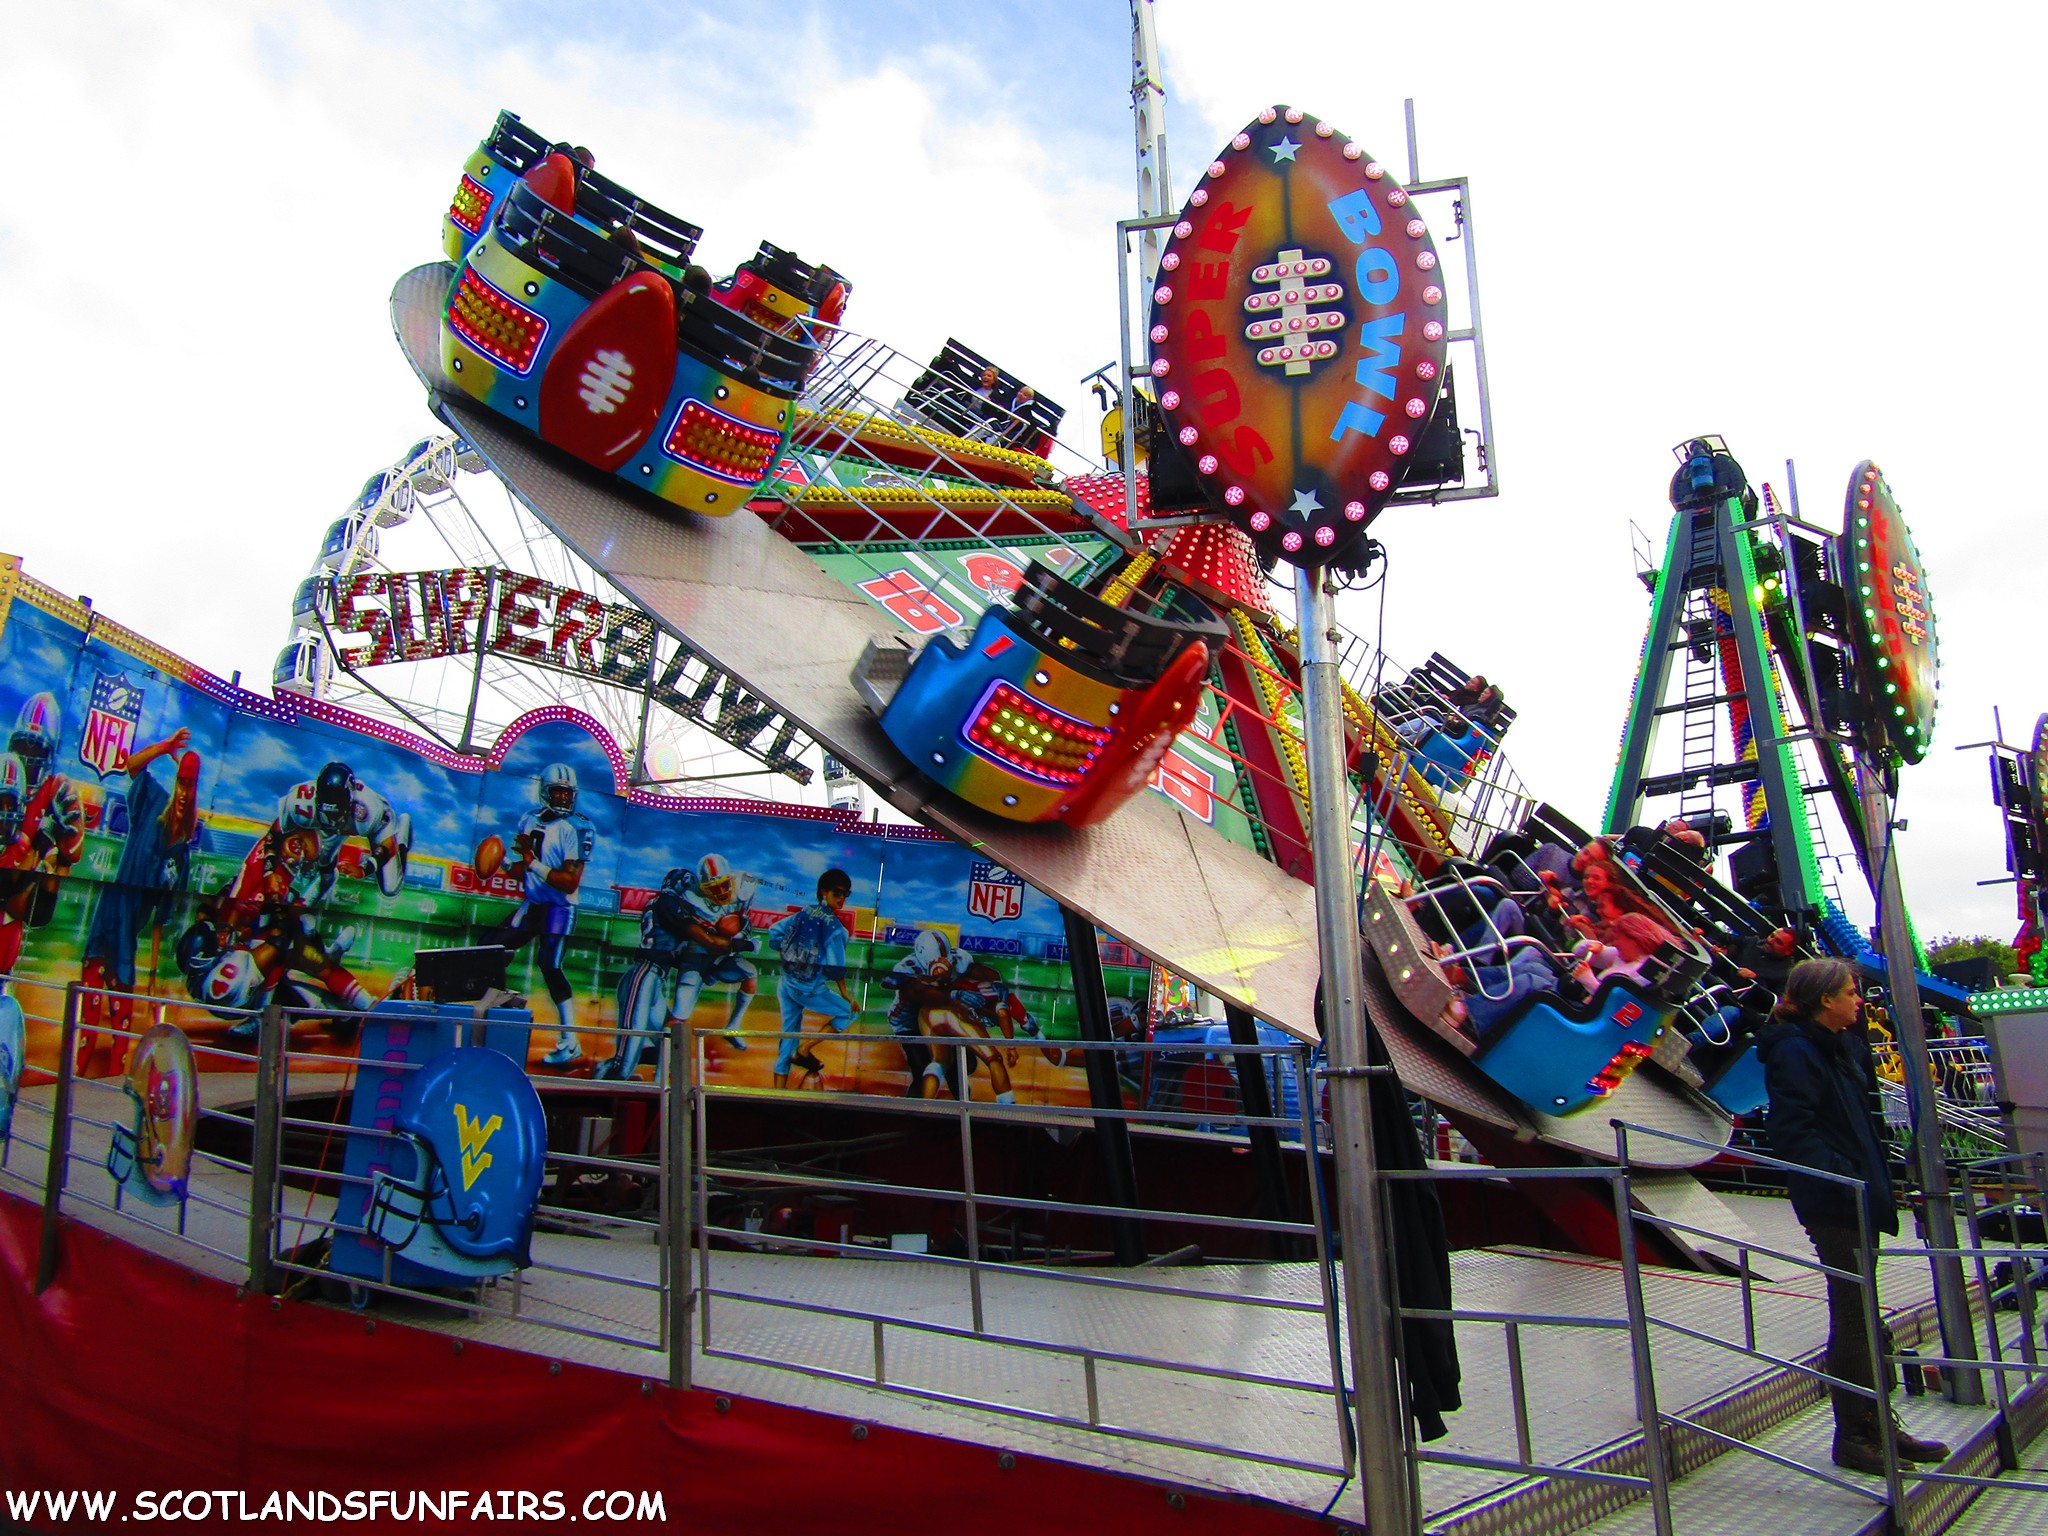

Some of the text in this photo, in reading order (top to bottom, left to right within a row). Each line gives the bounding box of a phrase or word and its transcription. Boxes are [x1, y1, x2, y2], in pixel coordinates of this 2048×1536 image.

[1185, 201, 1274, 476] SUPER
[1327, 188, 1406, 442] BOWL
[82, 710, 129, 771] NFL
[971, 882, 1020, 919] NFL
[1611, 1001, 1643, 1028] 2
